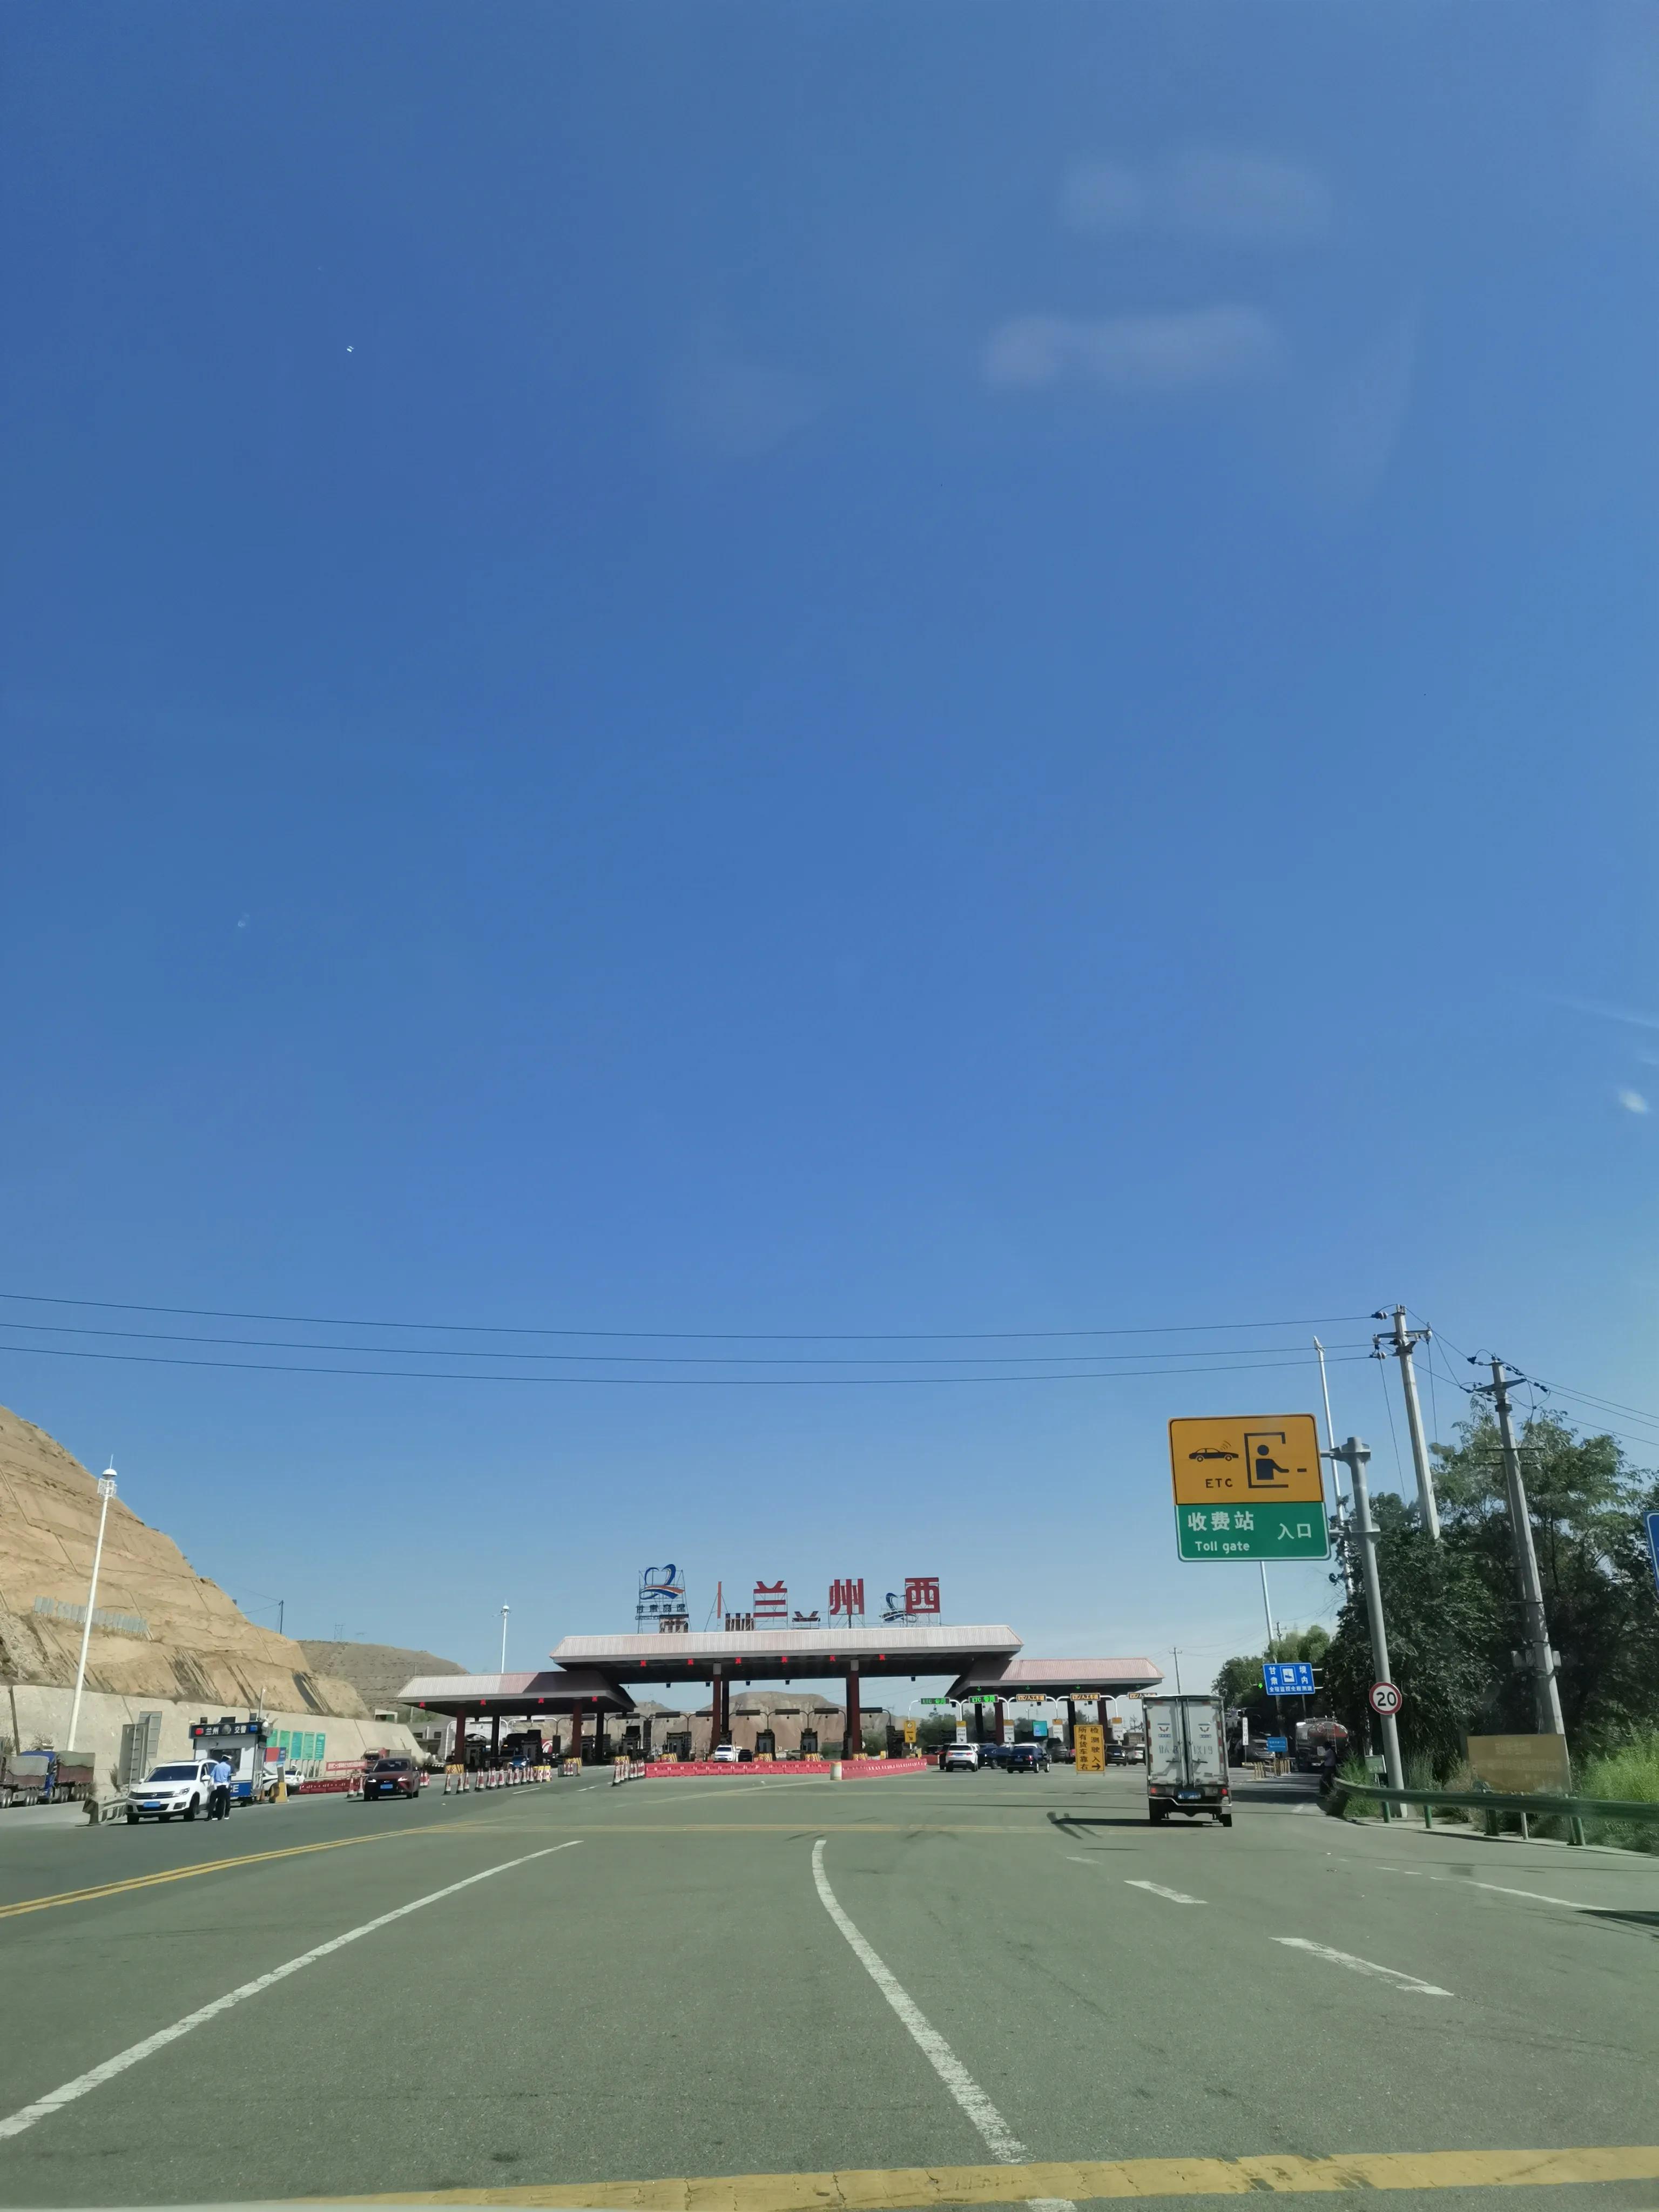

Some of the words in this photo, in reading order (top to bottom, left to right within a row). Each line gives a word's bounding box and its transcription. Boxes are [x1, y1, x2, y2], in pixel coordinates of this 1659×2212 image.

[1205, 1478, 1233, 1488] ETC
[1188, 1510, 1255, 1532] 收费站
[1277, 1523, 1312, 1540] 入口
[1195, 1541, 1218, 1552] Toll
[1222, 1541, 1250, 1555] gate
[1376, 1691, 1397, 1707] 20
[205, 1727, 219, 1736] 兰州
